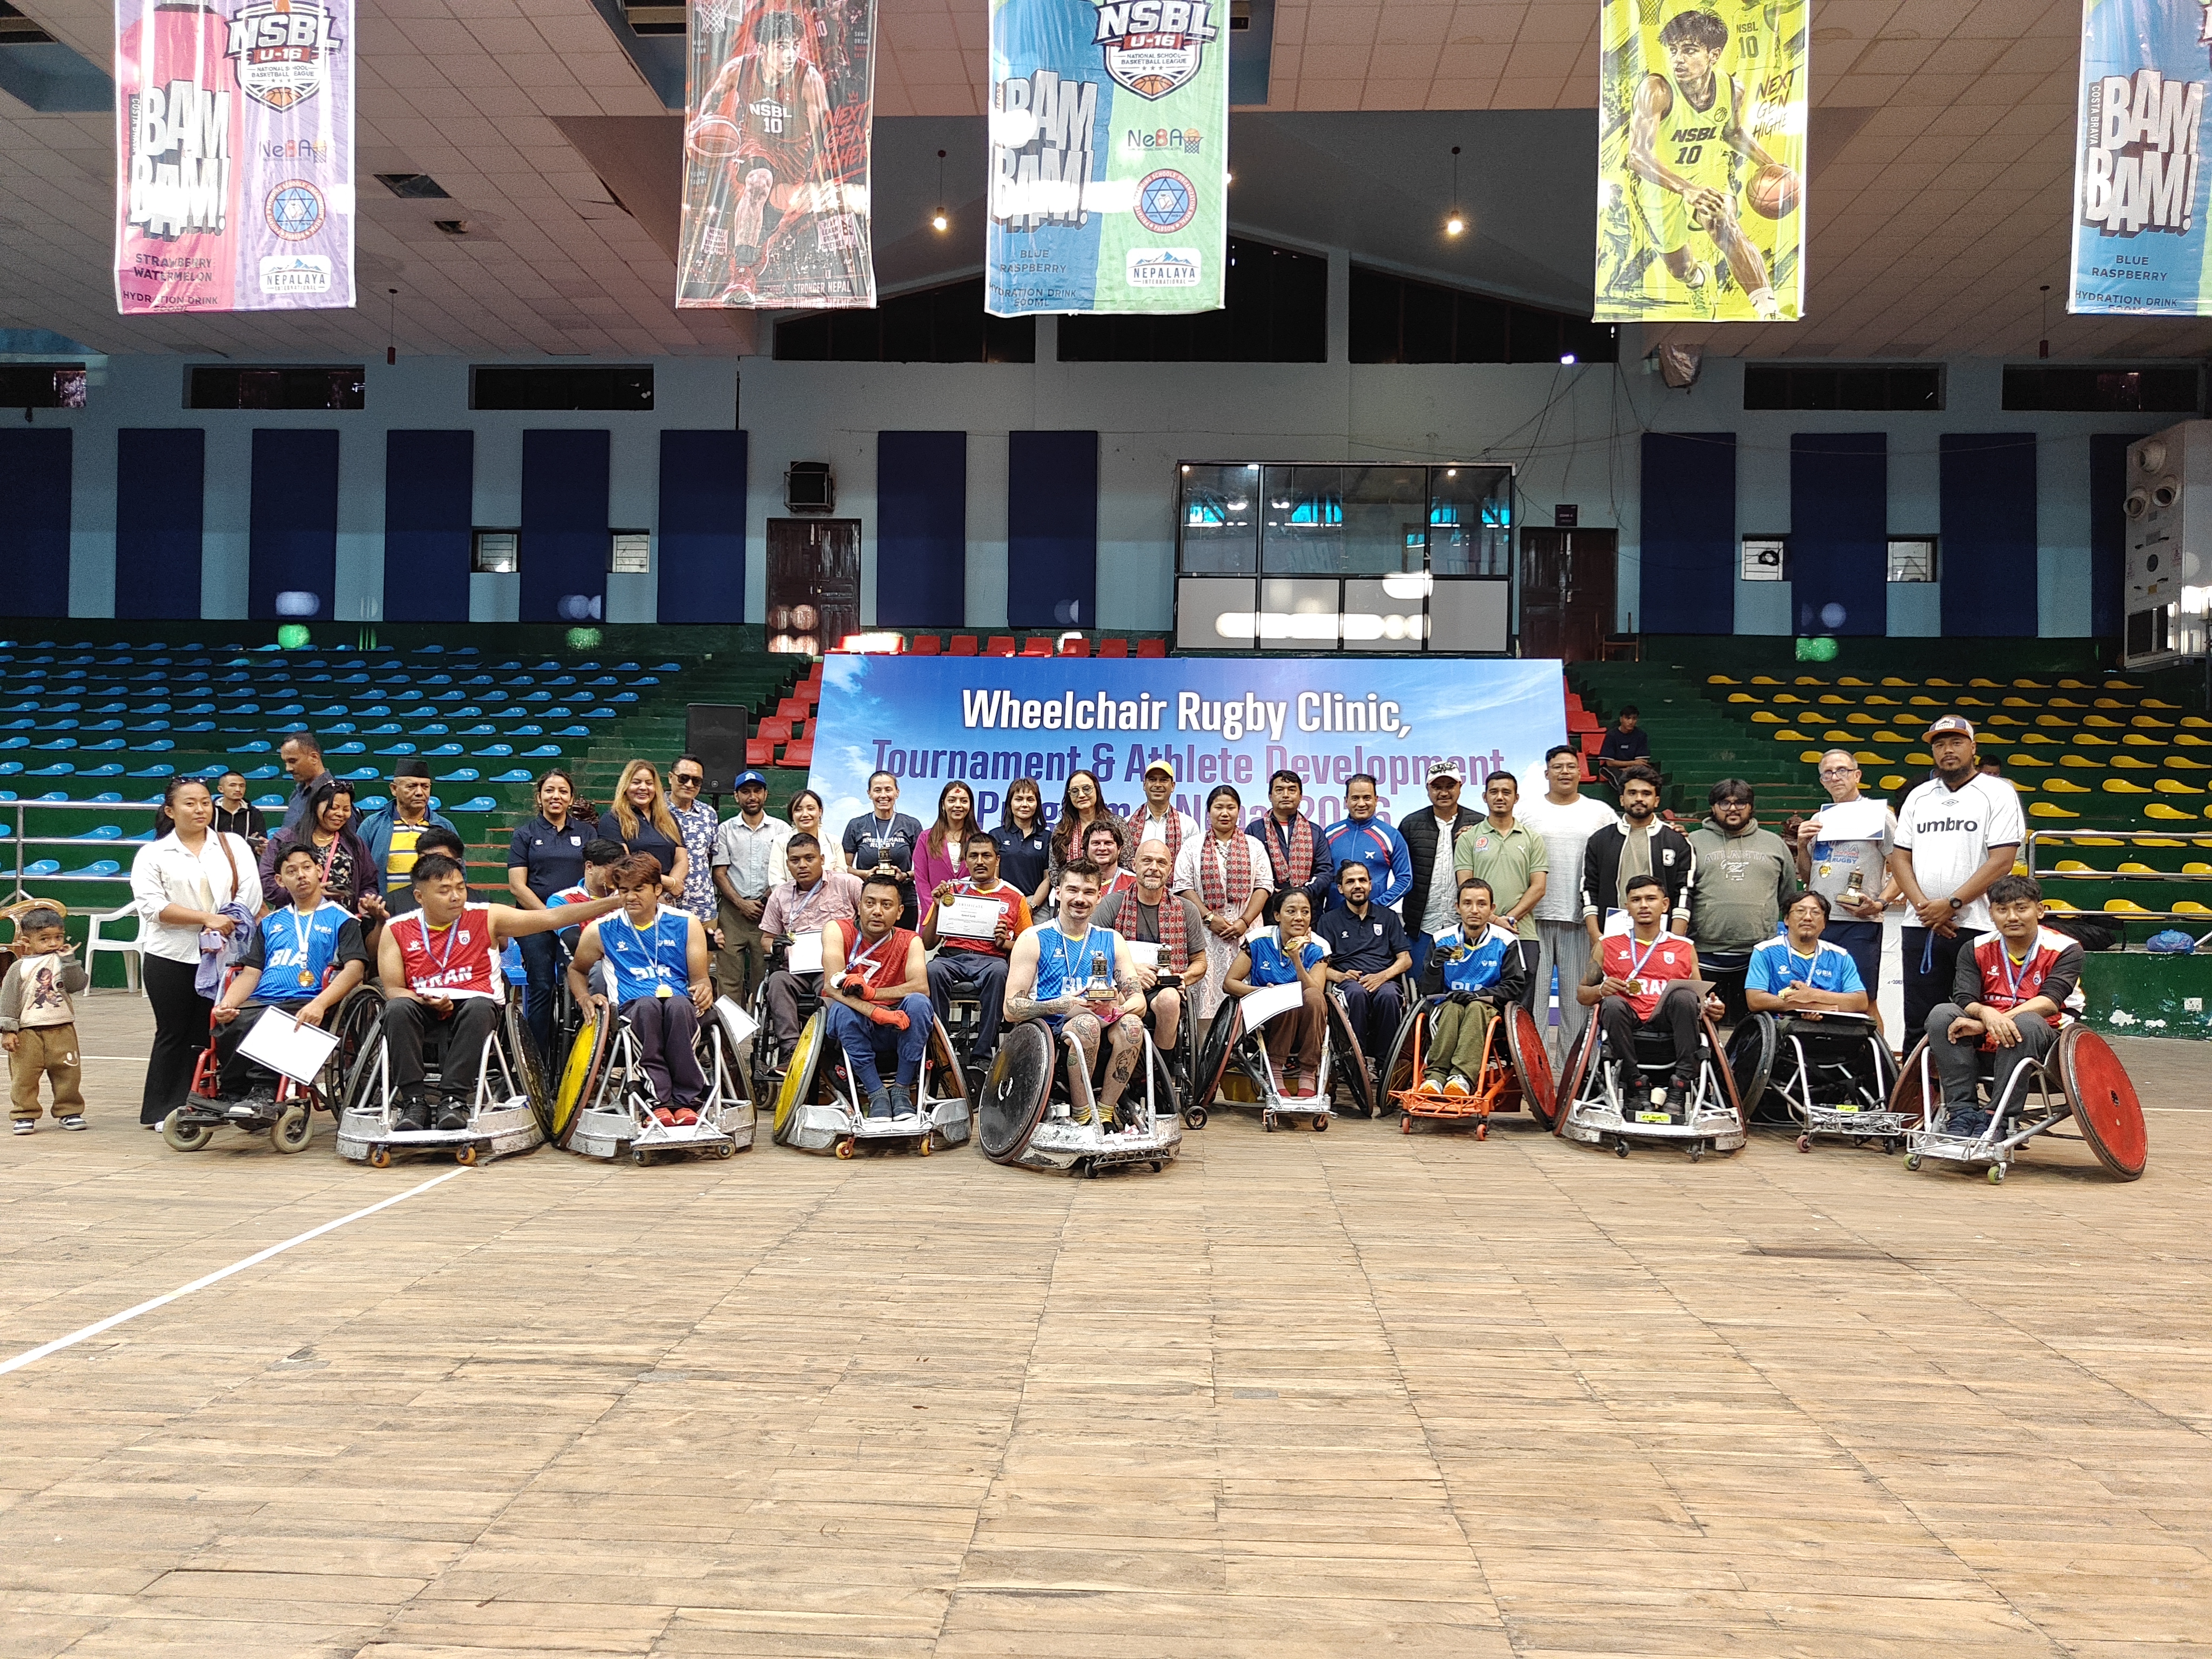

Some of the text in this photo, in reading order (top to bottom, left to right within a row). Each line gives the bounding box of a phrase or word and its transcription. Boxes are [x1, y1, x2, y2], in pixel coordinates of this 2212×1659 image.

[1097, 1, 1216, 41] NSBL
[1736, 21, 1759, 33] NSBL
[229, 15, 340, 52] NSBL
[1130, 35, 1176, 48] U-16
[260, 48, 302, 60] U-16
[1738, 35, 1759, 59] 10
[1755, 63, 1804, 102] NEXT
[749, 103, 793, 118] NSBL
[1004, 69, 1098, 152] BAM
[1757, 87, 1790, 119] GEN
[141, 80, 230, 159] BAM
[822, 99, 871, 130] NEXT
[2089, 85, 2101, 145] COSTA BRAVA
[2101, 70, 2203, 154] BAM
[764, 117, 783, 133] 10
[1752, 112, 1788, 141] HIGHE
[1128, 129, 1182, 147] NeBA
[1670, 126, 1717, 143] NSBL
[1675, 145, 1703, 164] 10
[130, 155, 230, 236] BAM!
[993, 147, 1094, 227] BAM!
[2086, 147, 2200, 232] BAM!
[135, 253, 212, 268] STRAWBERRY
[1020, 249, 1049, 259] BLUE
[2116, 255, 2149, 265] BLUE
[134, 267, 212, 282] WATERMELON
[1000, 263, 1067, 274] RASPBERRY
[1134, 267, 1195, 279] NEPALAYA
[2092, 267, 2168, 281] RASPBERRY
[267, 274, 326, 286] NEPALAYA
[793, 282, 825, 294] STRONGER
[827, 280, 852, 293] NEPAL
[123, 291, 218, 305] HYDRTION DRINK
[989, 282, 1076, 298] HYDRATION DRINK
[2075, 290, 2177, 307] HYDRATION DRINK
[1014, 299, 1049, 307] 500ML
[962, 689, 1412, 740] Wheelchair Rugby Clinic,
[872, 739, 1081, 781] Tournament
[1092, 743, 1115, 782] &
[1298, 795, 1391, 828] 206
[1917, 817, 1978, 833] umbro
[1704, 849, 1766, 862] ATLANTA
[270, 948, 305, 967] BIA
